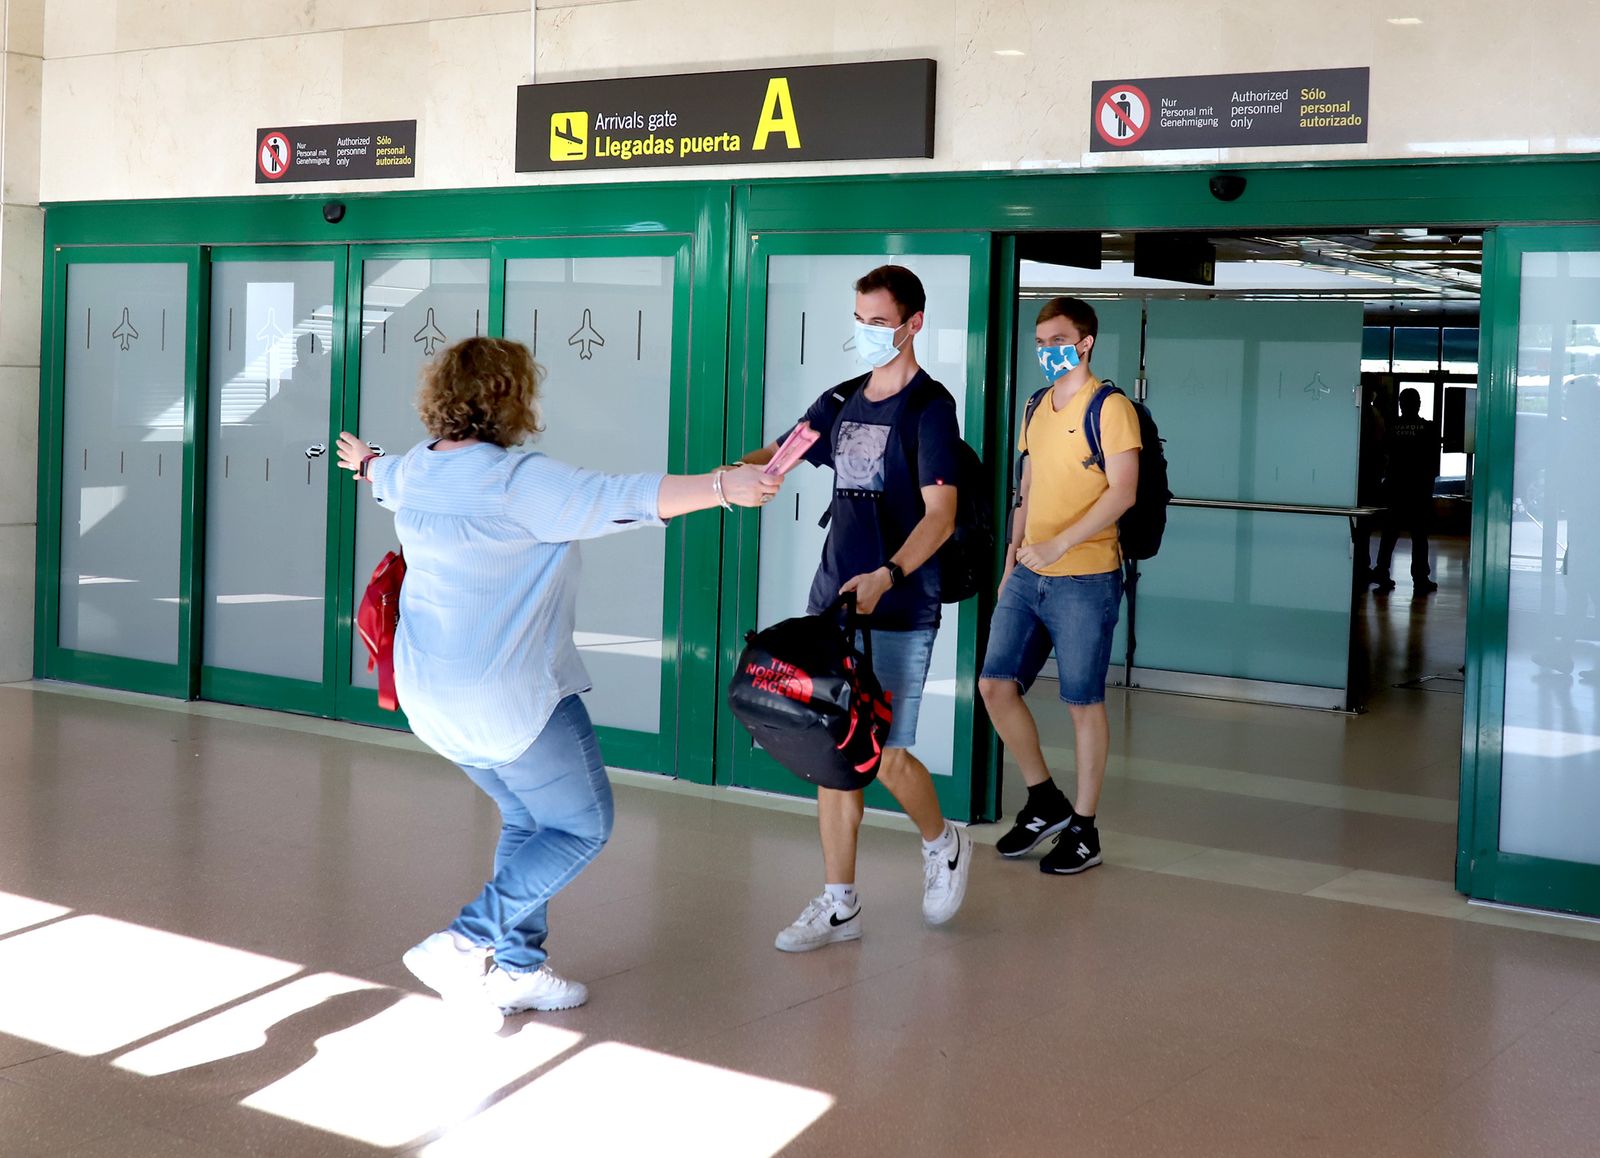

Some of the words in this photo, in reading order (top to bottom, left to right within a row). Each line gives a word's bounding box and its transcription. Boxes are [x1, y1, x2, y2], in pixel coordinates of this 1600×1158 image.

[1231, 89, 1288, 103] Authorized
[1301, 88, 1326, 100] Sólo
[1162, 98, 1177, 107] Nur
[1301, 101, 1350, 116] personal
[752, 78, 801, 150] A
[1161, 107, 1198, 118] Personal
[1199, 106, 1213, 116] mit
[1231, 102, 1282, 117] personnel
[595, 111, 644, 130] Arrivals
[648, 110, 677, 131] gate
[1160, 117, 1218, 128] Genehmigung
[1231, 117, 1253, 129] only
[1300, 115, 1361, 127] autorizado
[337, 137, 370, 146] Authorized
[377, 136, 391, 145] Sólo
[595, 134, 674, 160] Llegadas
[680, 132, 740, 157] puerta
[337, 147, 366, 156] personnel
[376, 145, 406, 158] personal
[296, 157, 330, 165] Genehmigung
[336, 157, 350, 167] only
[376, 155, 411, 165] autorizado
[745, 662, 792, 683] NORTH
[771, 657, 796, 676] THE
[751, 676, 786, 696] FACE
